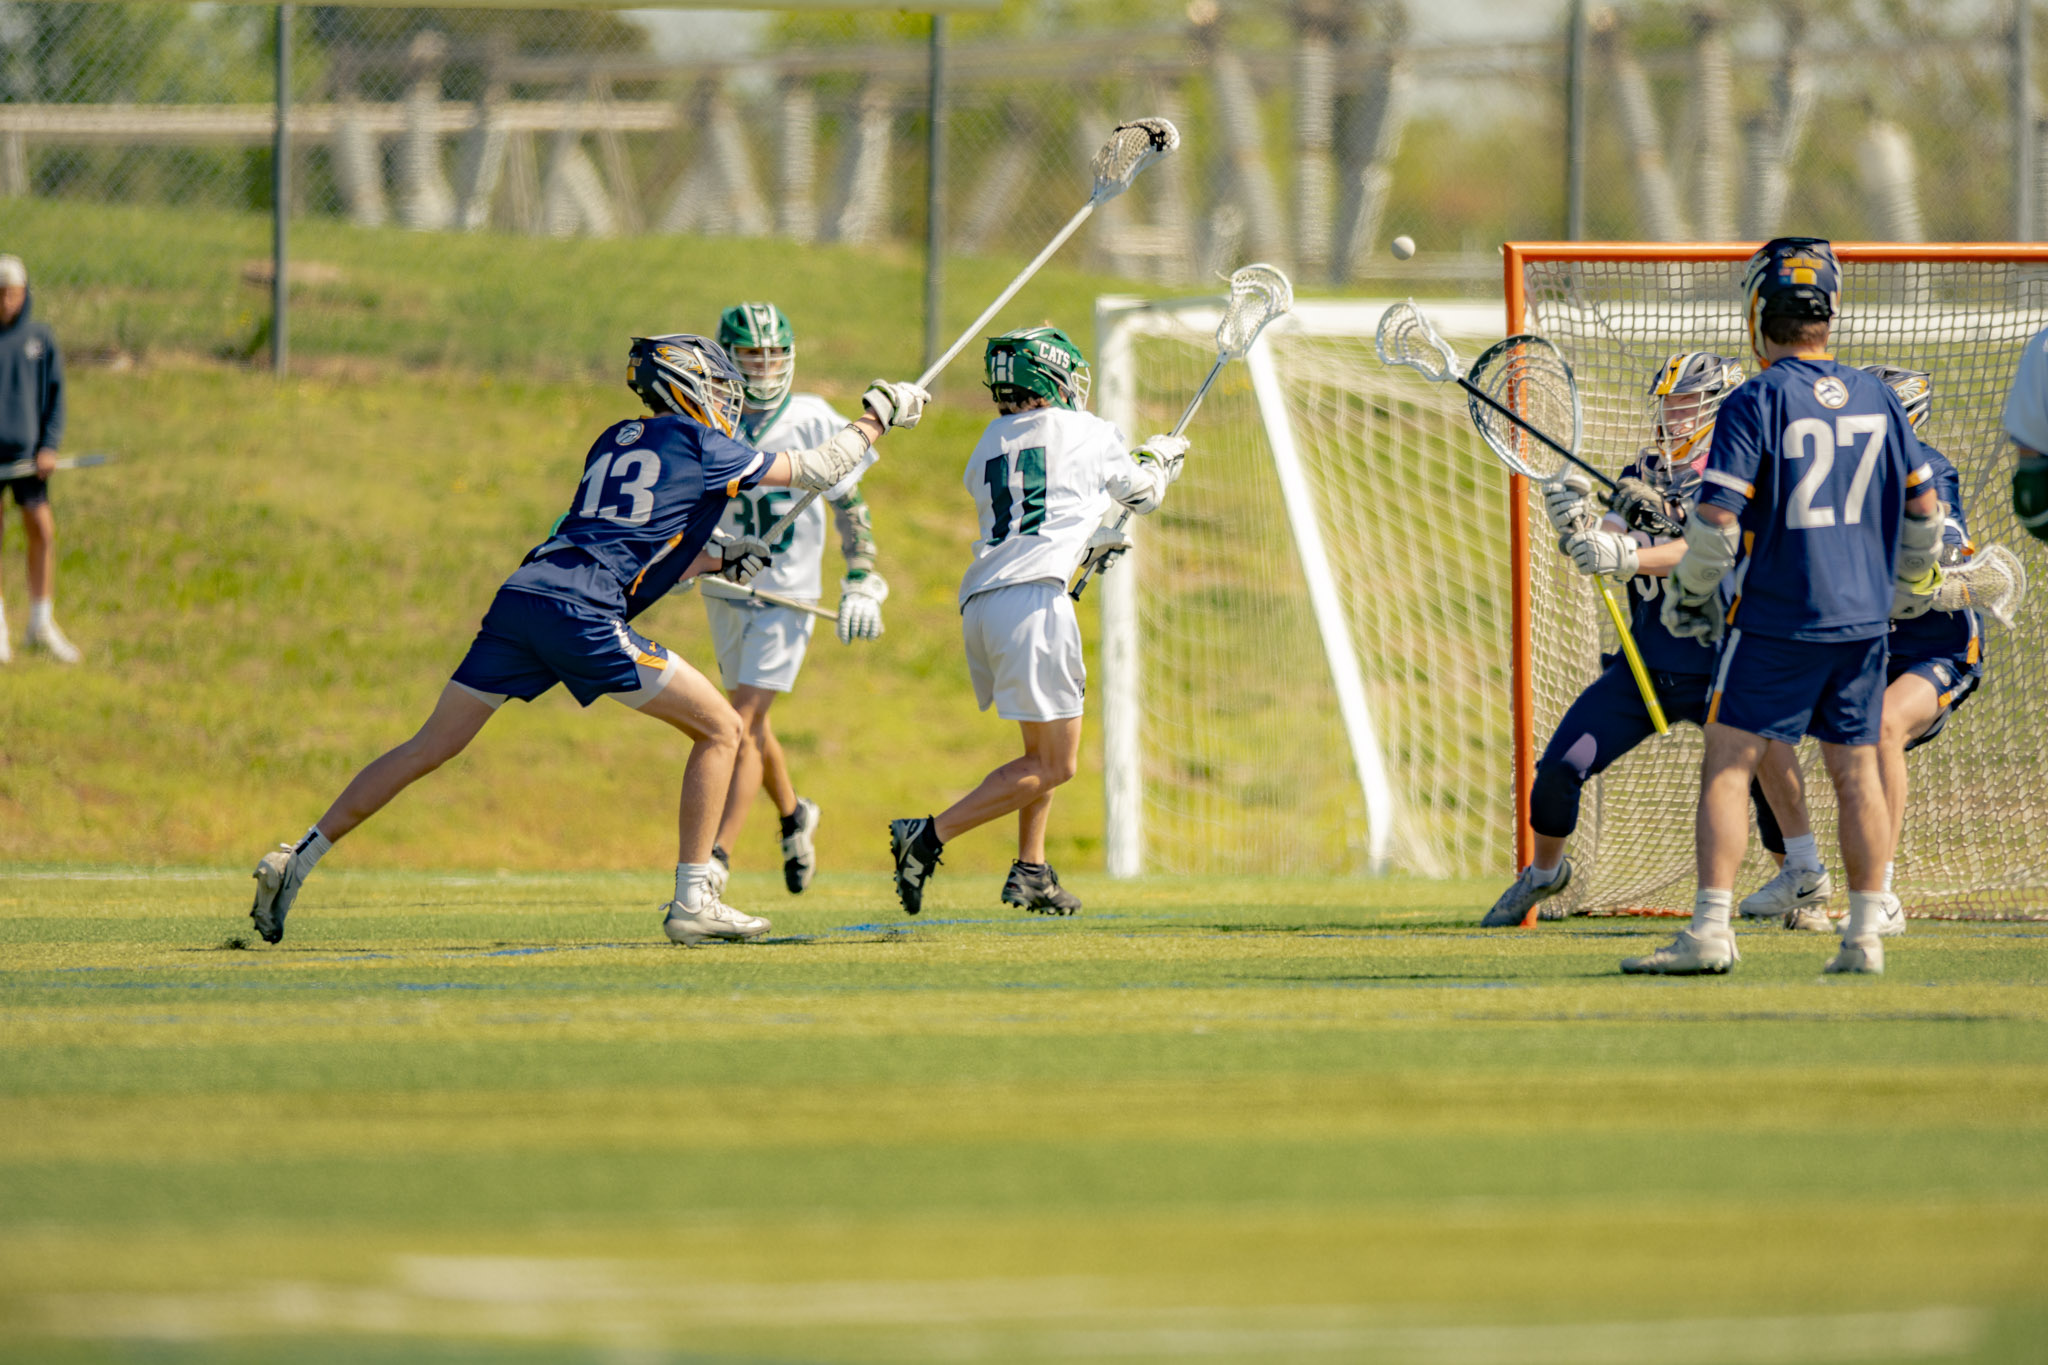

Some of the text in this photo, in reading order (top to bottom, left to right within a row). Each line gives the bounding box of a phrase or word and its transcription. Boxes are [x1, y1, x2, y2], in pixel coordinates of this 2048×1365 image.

[1039, 342, 1071, 369] CATS
[578, 448, 662, 528] 13
[983, 446, 1047, 547] 11
[1782, 413, 1888, 530] 27
